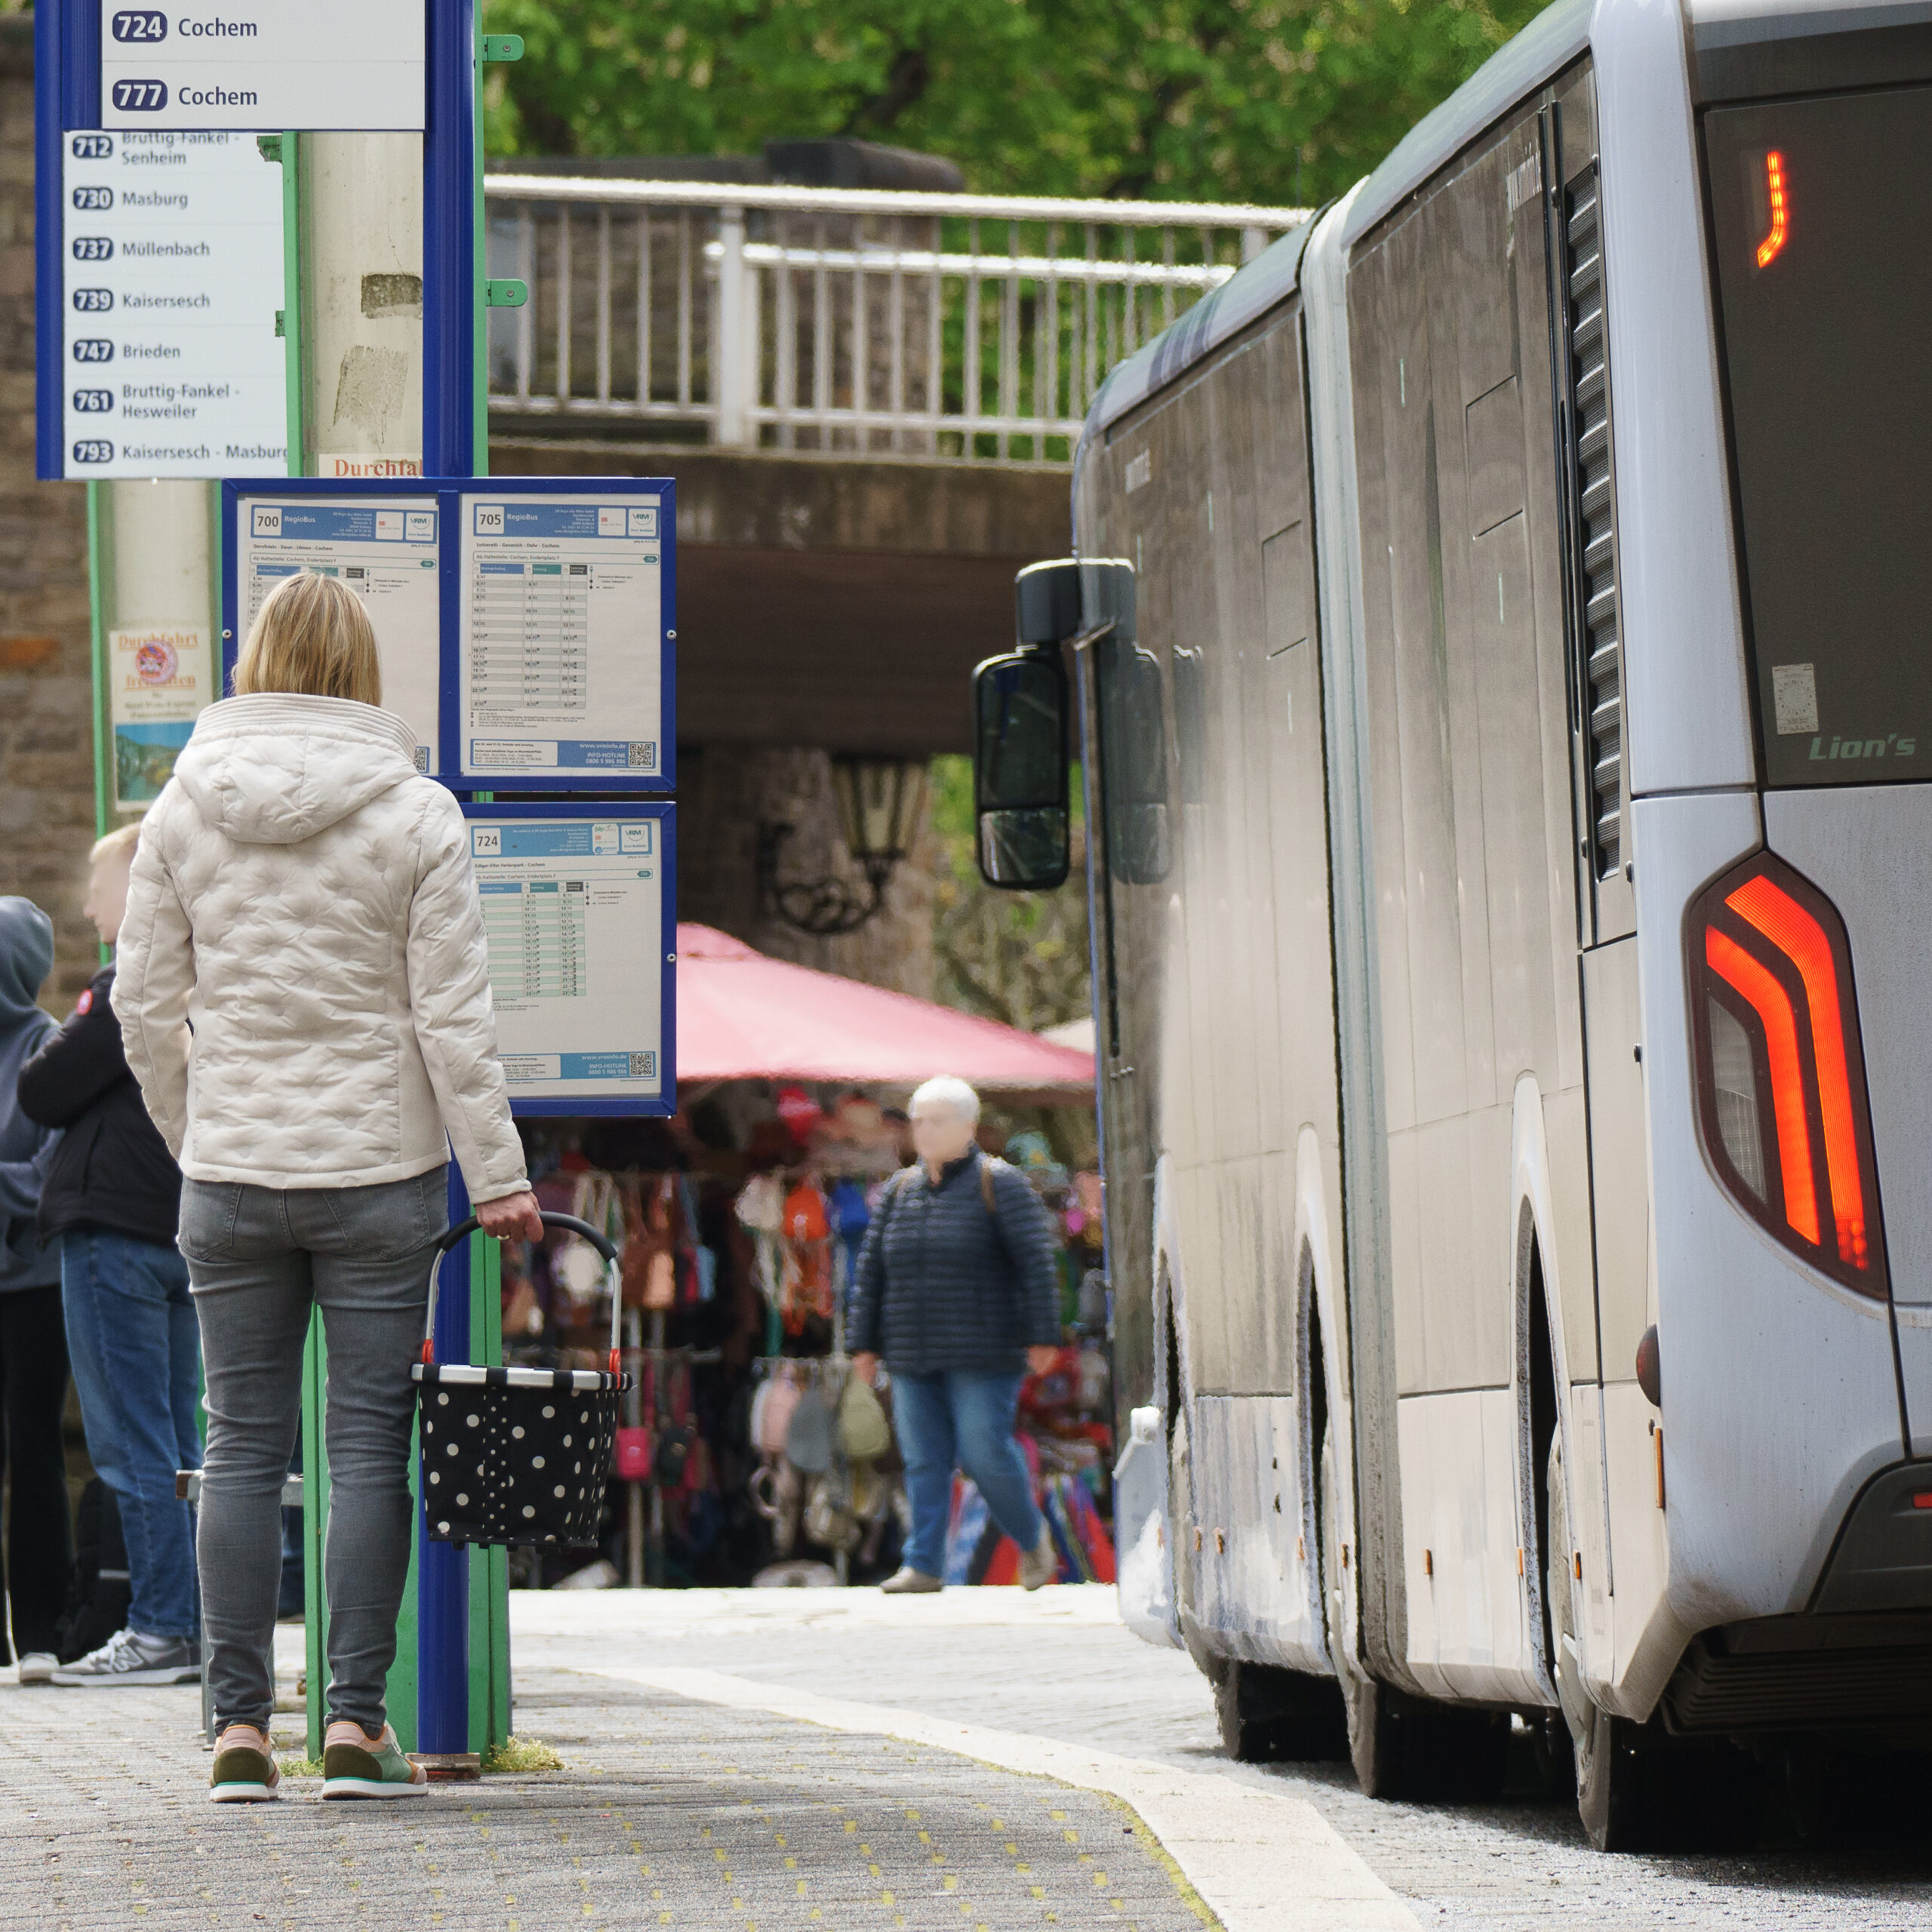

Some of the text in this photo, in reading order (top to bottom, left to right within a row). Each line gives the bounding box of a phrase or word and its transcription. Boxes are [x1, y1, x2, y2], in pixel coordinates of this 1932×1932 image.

[118, 16, 257, 38] 724 Cochem
[118, 85, 257, 106] 777 Cochem
[76, 137, 111, 156] 712
[122, 132, 229, 149] Bruttig-Fankel
[122, 150, 186, 165] Senheim
[76, 189, 188, 209] 730 Masburg
[76, 239, 210, 259] 737 Müllenbach
[76, 290, 210, 310] 739 Kaisersesch
[76, 341, 180, 361] 747 Brieden
[76, 391, 111, 411] 761
[122, 383, 229, 401] Bruttig-Fankel
[122, 405, 197, 418] Hesweiler
[76, 442, 111, 461] 793
[122, 445, 210, 459] Kaisersesch
[257, 516, 279, 527] 700
[480, 514, 501, 525] 705
[1808, 733, 1916, 760] Lion's
[477, 836, 498, 846] 724
